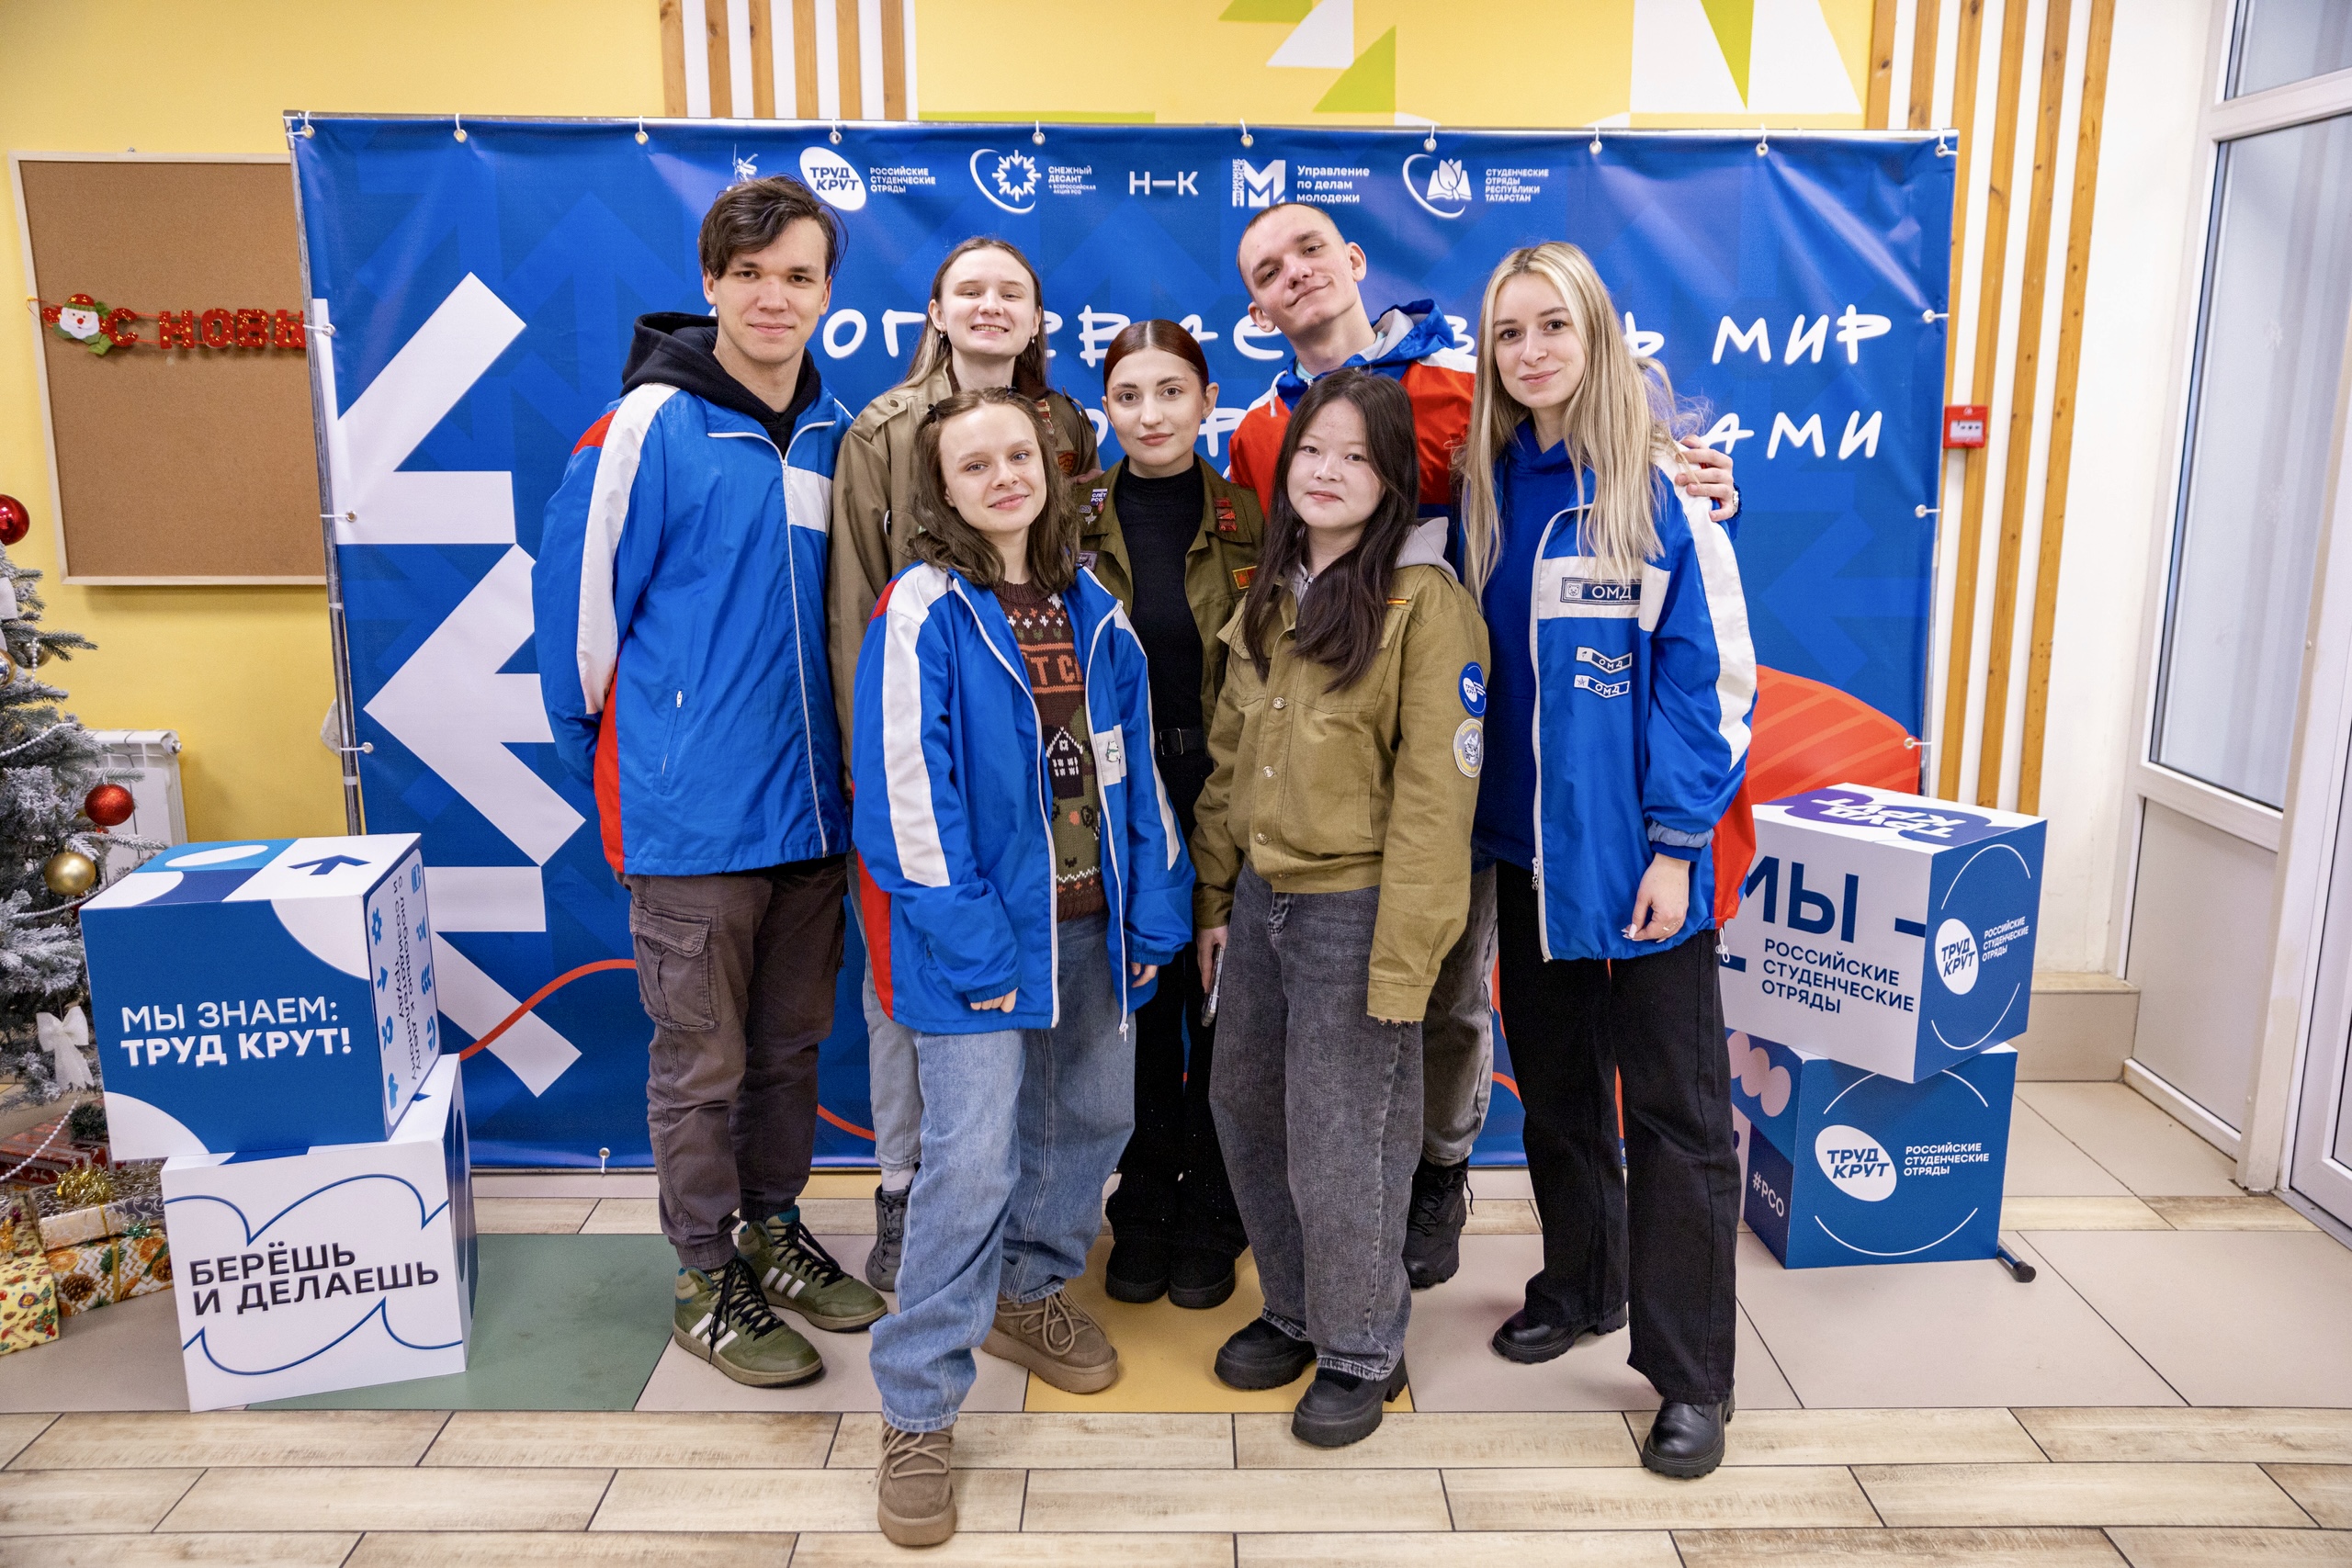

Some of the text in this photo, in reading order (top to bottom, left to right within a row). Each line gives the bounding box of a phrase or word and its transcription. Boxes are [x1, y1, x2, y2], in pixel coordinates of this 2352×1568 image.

[809, 167, 850, 178] ТРУД
[870, 165, 929, 176] РОССИЙСКИЕ
[1048, 165, 1092, 175] СНЕЖНЫЙ
[1297, 165, 1370, 178] Управление
[1486, 168, 1549, 177] СТУДЕНЧЕСКИЕ
[816, 179, 859, 191] КРУТ
[870, 175, 936, 185] СТУДЕНЧЕСКИЕ
[1048, 175, 1082, 183] ДЕСАНТ
[1296, 180, 1352, 190] по делам
[1485, 177, 1521, 186] ОТРЯДЫ
[870, 185, 907, 194] ОТРЯДЫ
[1485, 186, 1541, 194] РЕСПУБЛИКИ
[1296, 194, 1360, 204] молодежи
[1485, 194, 1532, 202] ТАТАРСТАН
[107, 308, 139, 348] С
[1713, 304, 1892, 365] МИР
[1591, 585, 1632, 600] ОМД
[1599, 658, 1623, 670] ОМД
[1595, 683, 1620, 696] ОМД
[1984, 917, 2026, 939] РОССИЙСКИЕ
[1984, 926, 2029, 951] СТУДЕНЧЕСКИЕ
[1941, 938, 1970, 962] ТРУД
[1982, 944, 2007, 962] ОТРЯДЫ
[1765, 938, 1899, 987] РОССИЙСКИЕ
[1943, 951, 1975, 977] КРУТ
[394, 956, 404, 1018] труду
[395, 900, 416, 1080] созидательному
[400, 896, 413, 995] любовью
[412, 1021, 421, 1071] делу
[1763, 959, 1915, 1012] СТУДЕНЧЕСКИЕ
[1762, 980, 1840, 1013] ОТРЯДЫ
[121, 996, 338, 1034] МЫ ЗНАЕМ:
[120, 1028, 352, 1067] ТРУД КРУТ!
[1826, 1148, 1879, 1165] ТРУД
[1905, 1142, 1982, 1155] РОССИЙСКИЕ
[1905, 1154, 1989, 1166] СТУДЕНЧЕСКИЕ
[1832, 1162, 1890, 1179] КРУТ
[1904, 1166, 1950, 1177] ОТРЯДЫ
[1752, 1171, 1785, 1217] #РСО
[189, 1241, 356, 1286] БЕРЁШЬ
[193, 1261, 439, 1315] И ДЕЛАЕШЬ
